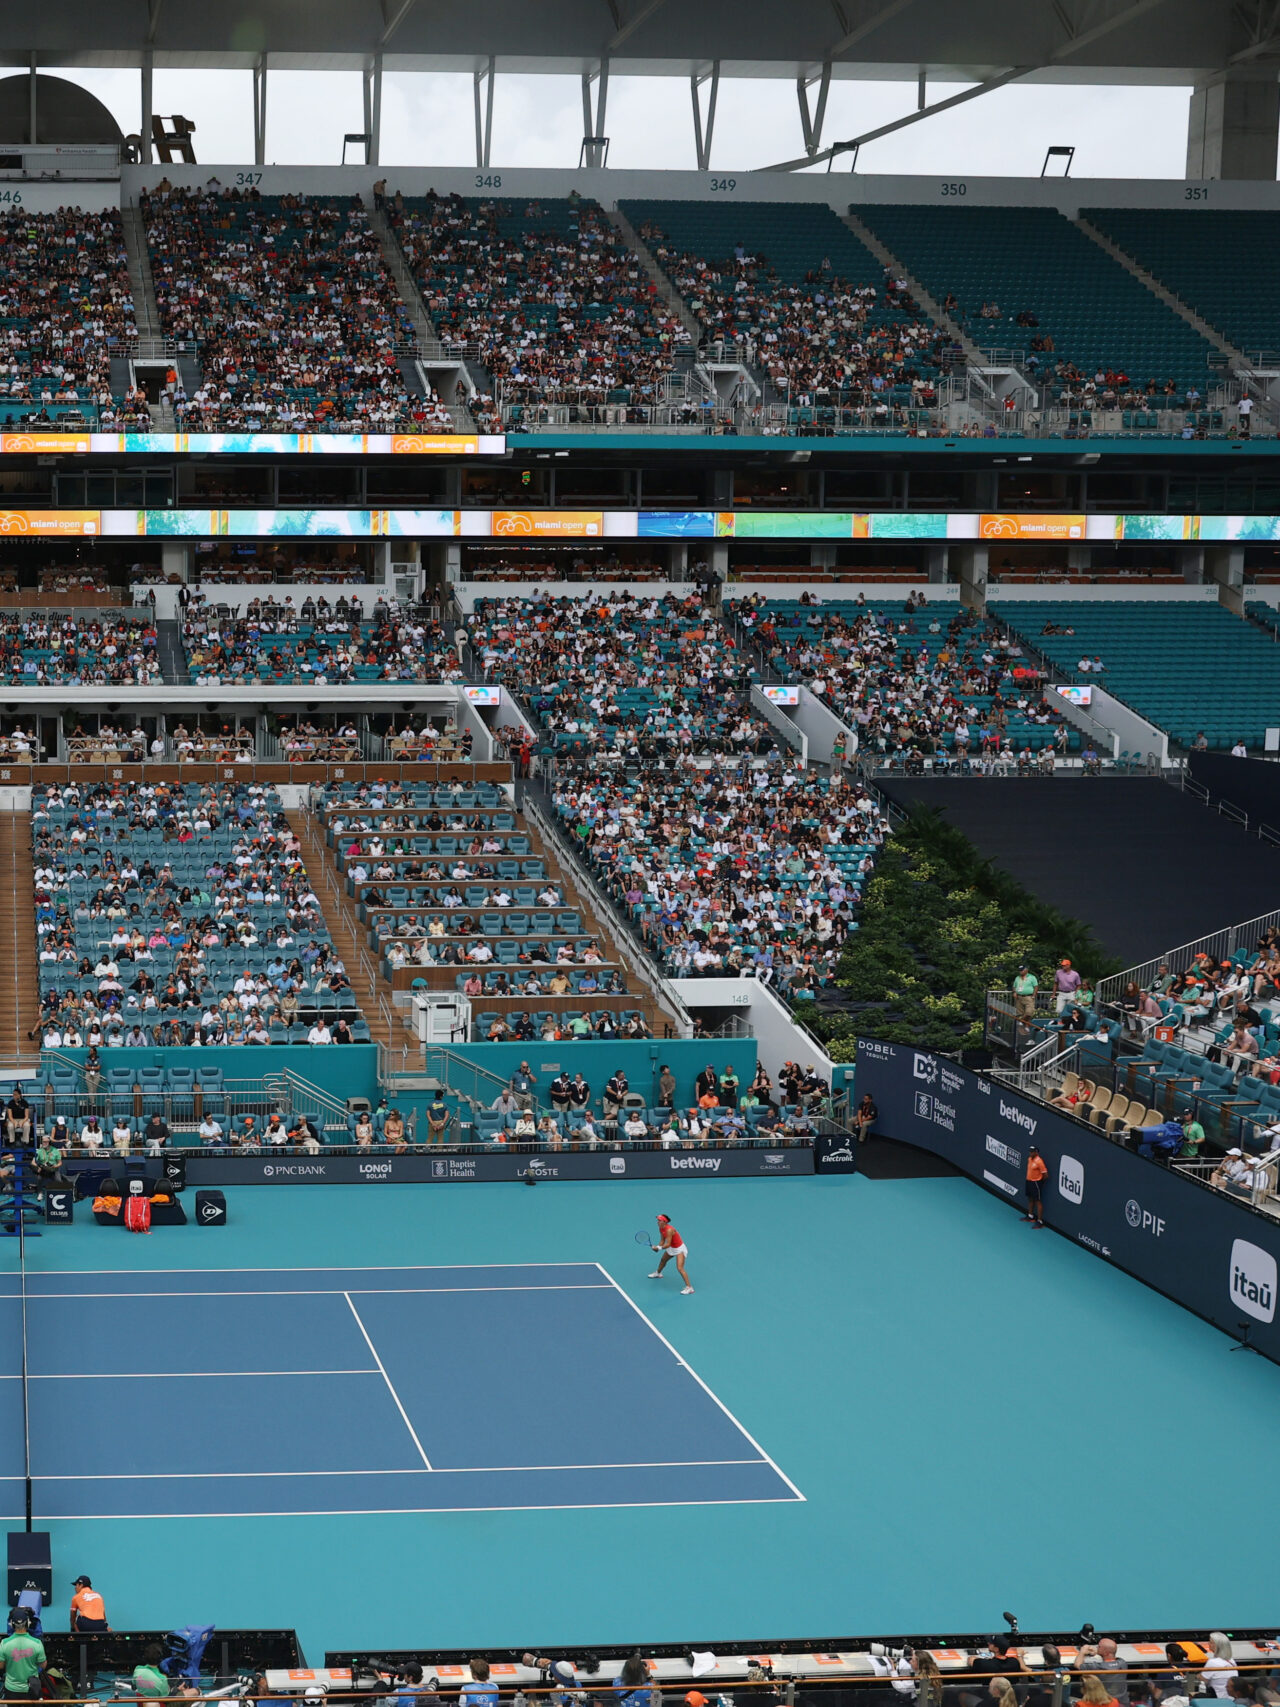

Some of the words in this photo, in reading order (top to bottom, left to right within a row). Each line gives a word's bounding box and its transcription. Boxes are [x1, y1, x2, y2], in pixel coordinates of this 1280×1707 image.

[236, 173, 263, 185] 347
[475, 175, 502, 188] 348
[710, 179, 737, 191] 349
[941, 183, 967, 196] 350
[1184, 188, 1208, 200] 351
[30, 520, 57, 528] miami
[59, 521, 80, 529] open
[535, 521, 561, 529] miami
[562, 522, 583, 530] open
[1047, 525, 1067, 533] open
[0, 612, 20, 621] Rock
[732, 995, 749, 1004] 148
[858, 1041, 896, 1056] DOBEL
[934, 1098, 956, 1119] Baptist
[933, 1111, 955, 1132] Health
[1000, 1099, 1037, 1136] betway
[845, 1138, 850, 1146] 2
[450, 1160, 476, 1170] Baptist
[670, 1156, 721, 1171] betway
[275, 1166, 298, 1175] PNC
[298, 1165, 327, 1175] BANK
[450, 1169, 476, 1177] Health
[1060, 1171, 1080, 1197] itaú
[1142, 1210, 1166, 1237] PIF
[1078, 1232, 1101, 1251] LACOSTE
[1233, 1266, 1271, 1311] itaú
